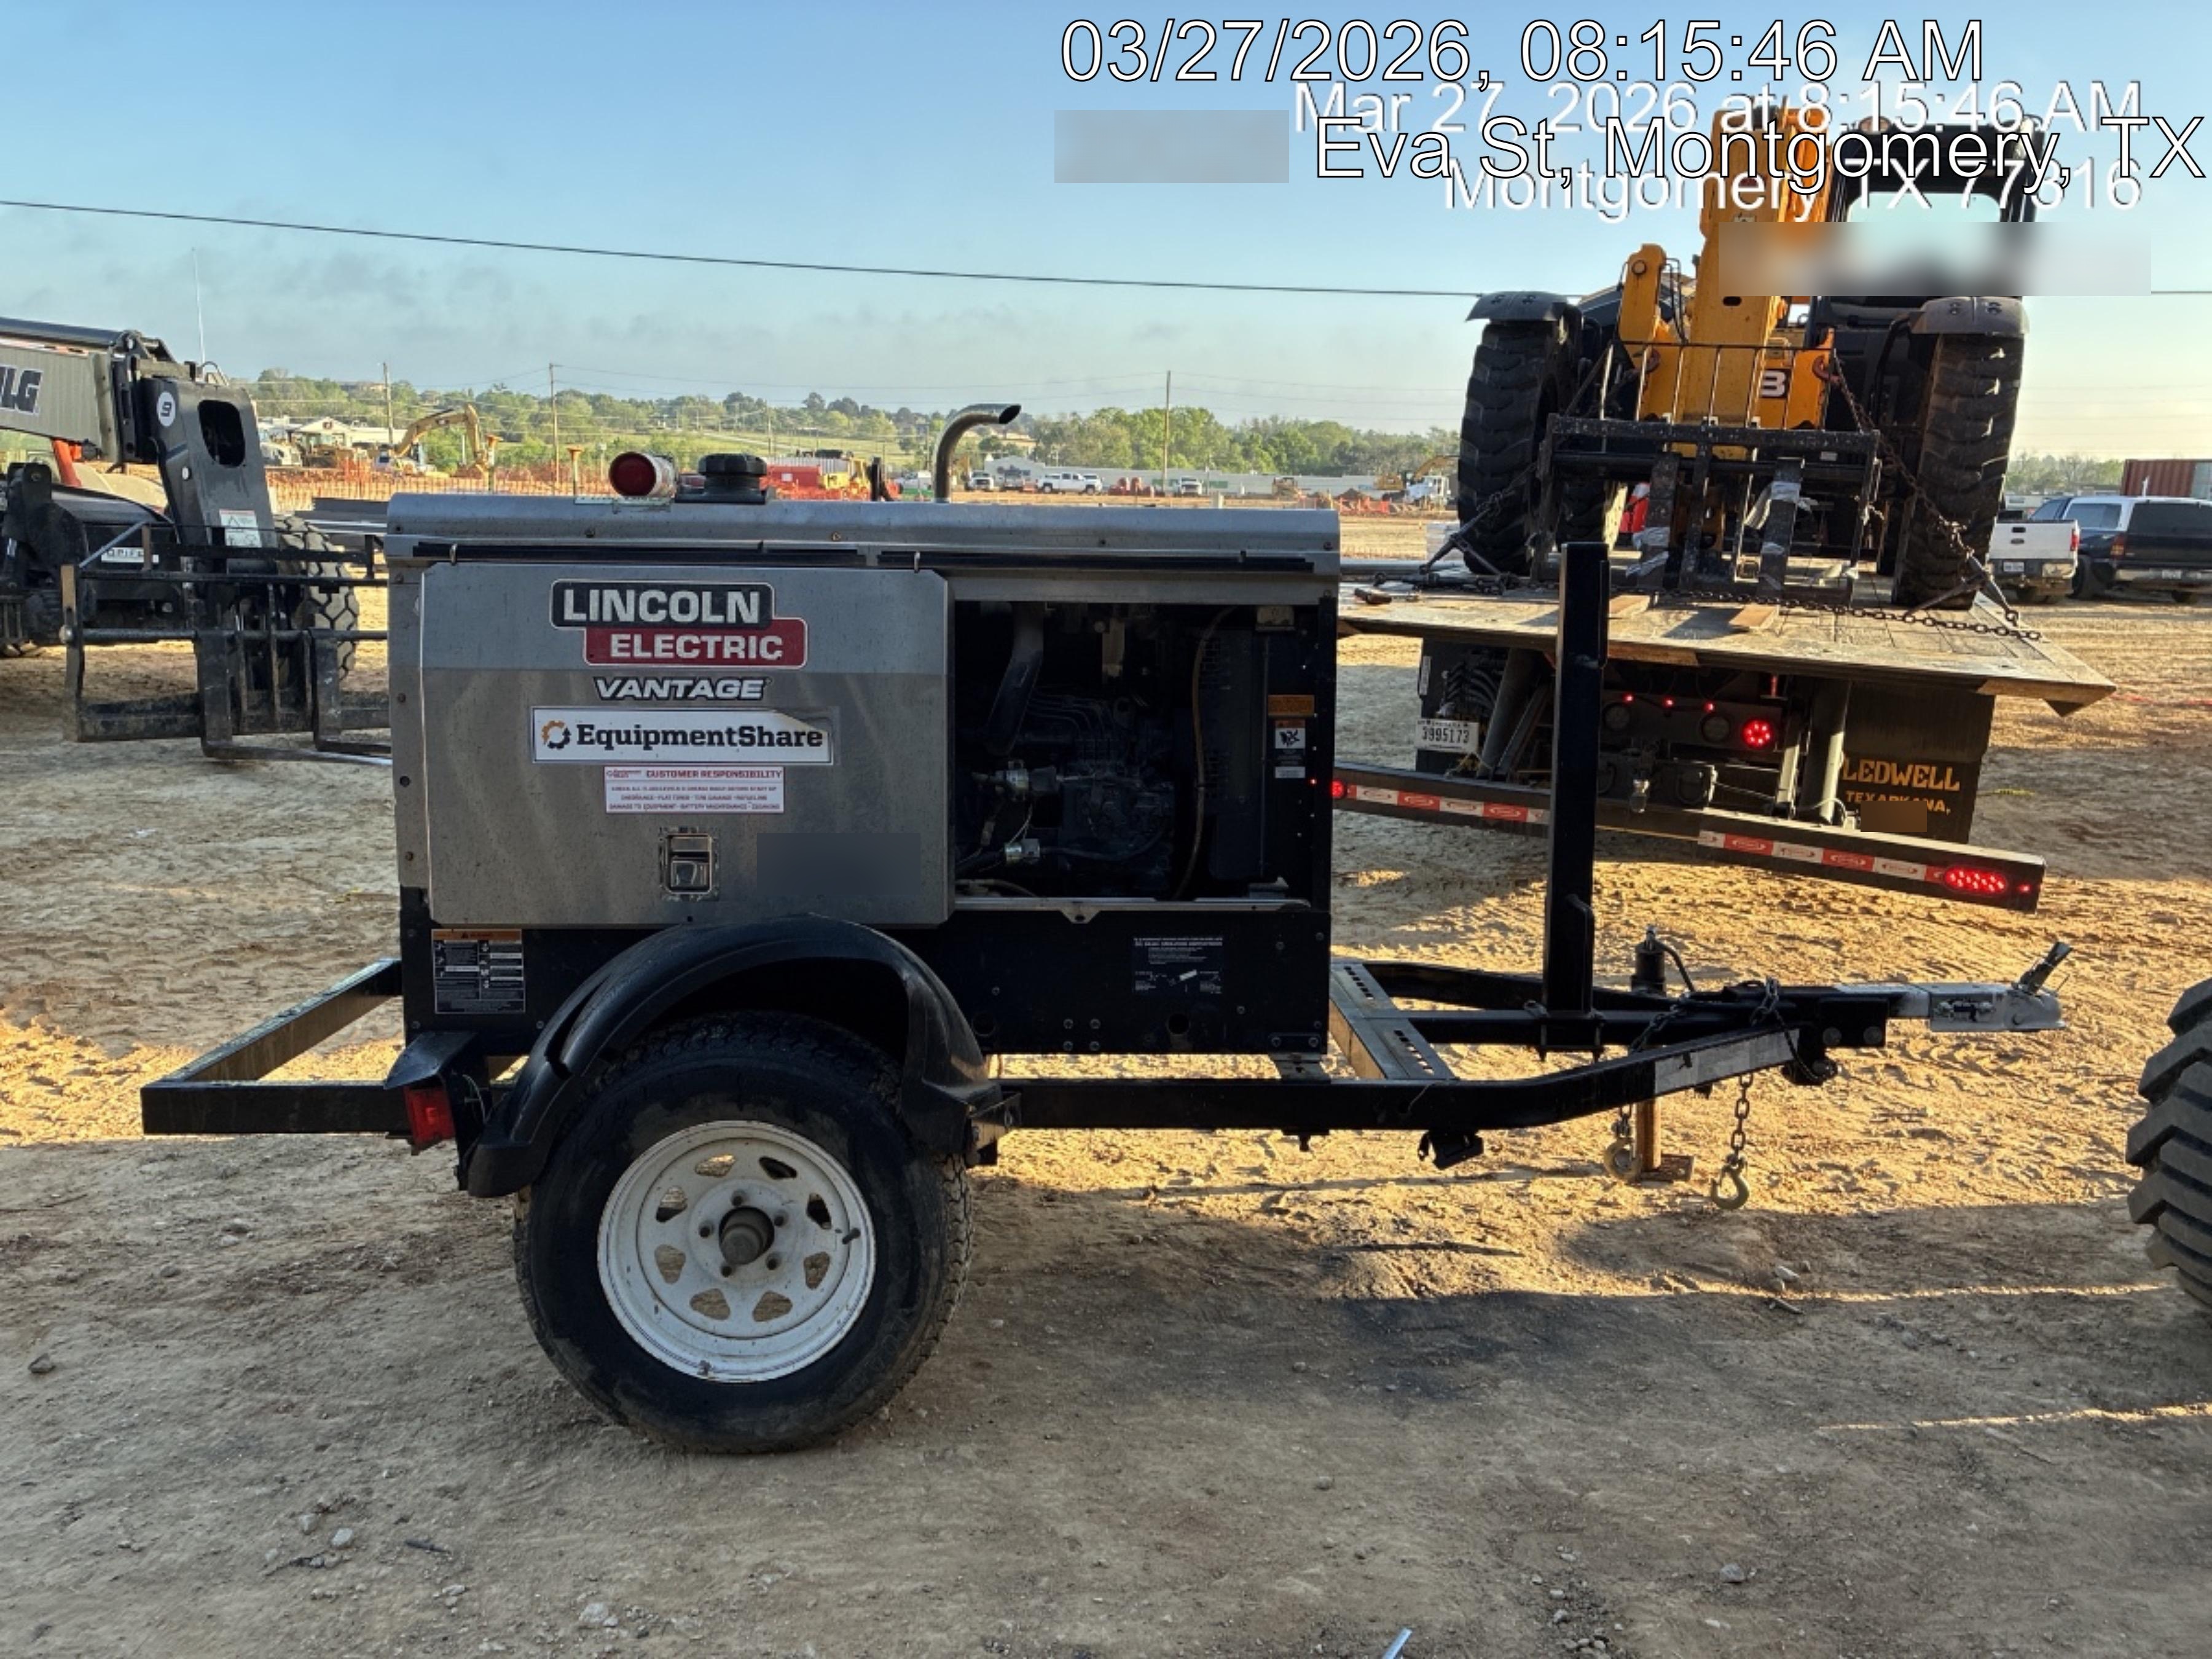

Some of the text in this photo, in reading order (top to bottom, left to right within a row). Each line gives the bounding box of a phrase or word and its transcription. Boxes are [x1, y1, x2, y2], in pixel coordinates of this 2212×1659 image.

[563, 589, 759, 624] LINCOLN
[610, 633, 783, 661] ELECTRIC
[594, 677, 766, 700] VANTAGE
[576, 723, 823, 750] EquipmentShare
[646, 769, 699, 779] CUSTOMER
[700, 770, 782, 779] RESPONSIBILITY
[1841, 756, 1961, 791] LEDWELL
